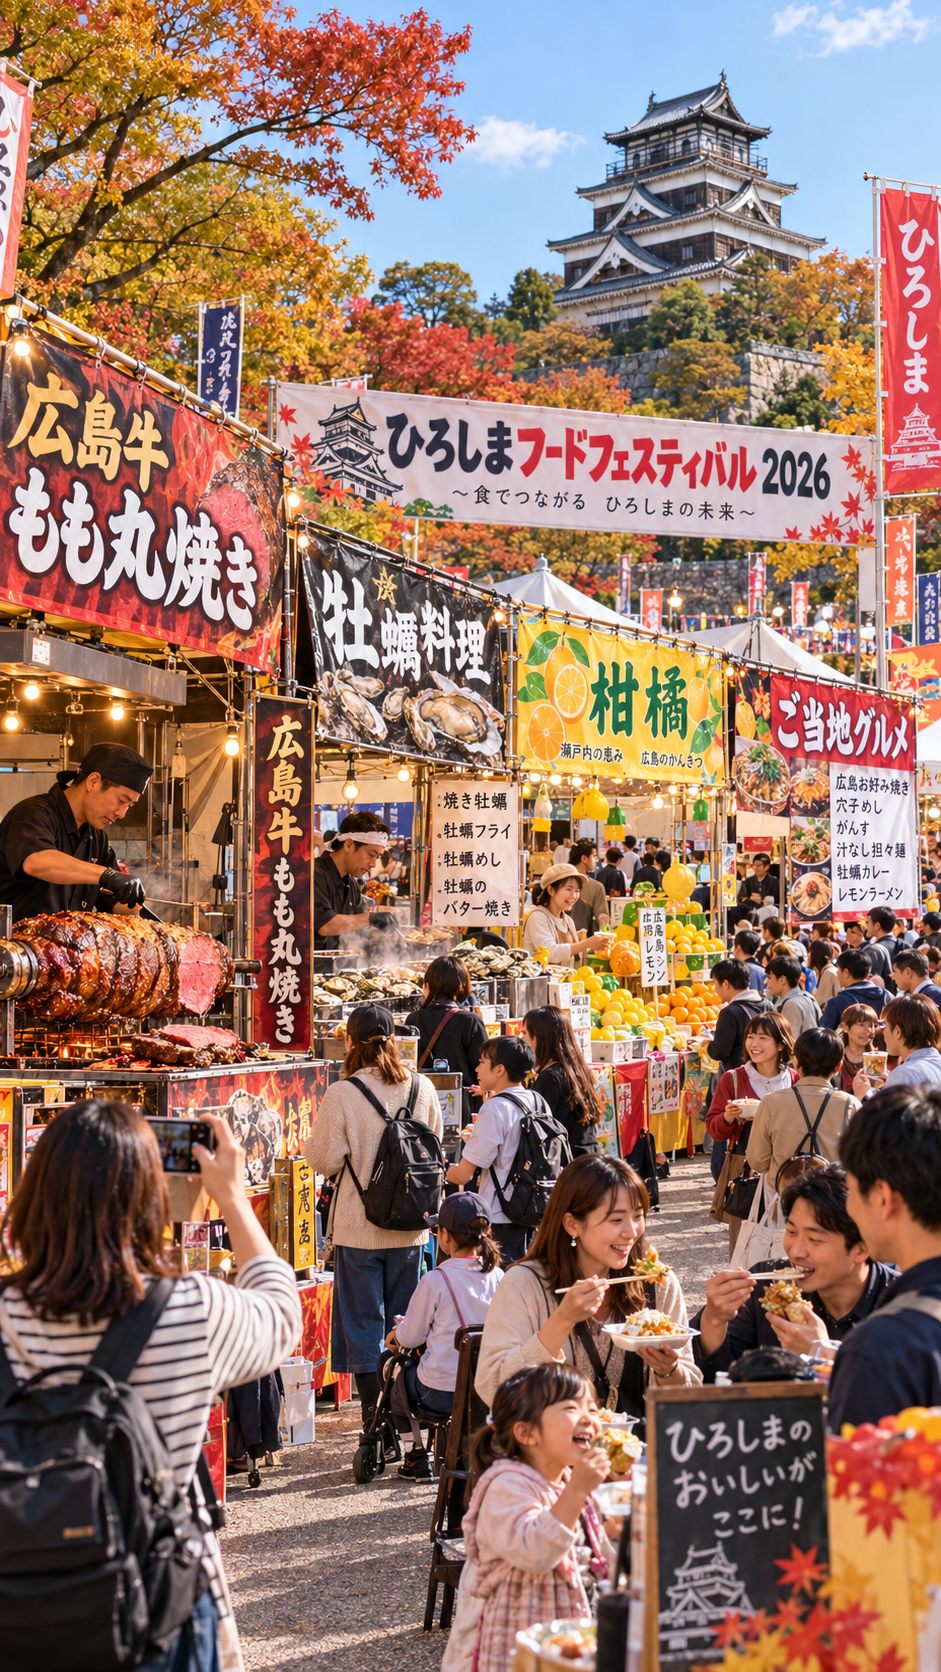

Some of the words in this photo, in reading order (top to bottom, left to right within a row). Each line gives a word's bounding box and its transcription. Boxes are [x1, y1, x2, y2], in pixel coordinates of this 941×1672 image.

[898, 219, 935, 394] ひろしま
[7, 371, 170, 493] 広島牛
[9, 467, 258, 631] もも丸焼き
[321, 569, 492, 686] 牡蠣料理
[588, 660, 689, 741] 柑橘
[777, 690, 909, 760] ご当地グルメ
[561, 742, 624, 763] 瀬戸内の恵み
[640, 751, 703, 769] 広島のかんきつ
[835, 773, 910, 796] 広島お好み焼き
[443, 791, 507, 811] 焼き牡蠣
[836, 797, 883, 815] 穴子めし
[443, 822, 511, 840] 牡蠣フライ
[836, 820, 870, 836] がんす
[443, 851, 502, 868] 牡蠣めし
[837, 864, 890, 881] 牡蠣カレー
[266, 714, 305, 1044] 広島牛もも丸焼き
[443, 878, 487, 895] 牡蠣の
[838, 887, 904, 902] レモンラーメン
[443, 900, 511, 917] バター焼き
[665, 1414, 812, 1463] ひろしまの
[673, 1450, 817, 1509] おいしいが
[713, 1496, 804, 1538] ここに!
